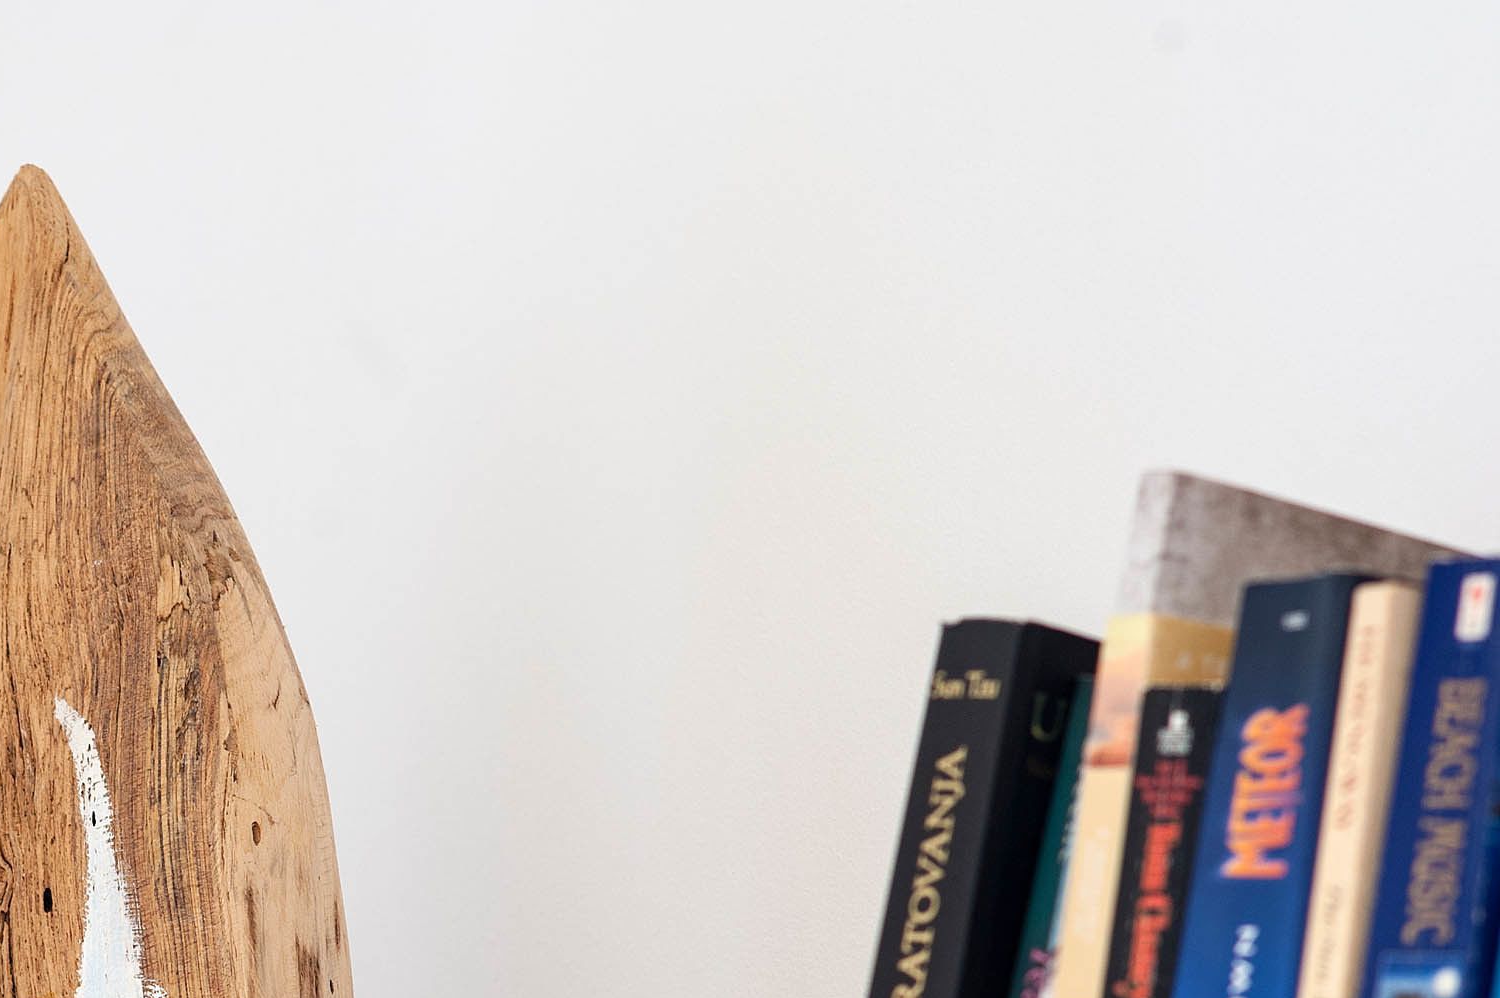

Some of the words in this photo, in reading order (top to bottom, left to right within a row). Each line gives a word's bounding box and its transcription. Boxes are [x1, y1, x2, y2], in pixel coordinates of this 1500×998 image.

[1220, 703, 1312, 880] METEOR
[1422, 676, 1489, 810] BEACH
[1401, 814, 1468, 947] MUSIC
